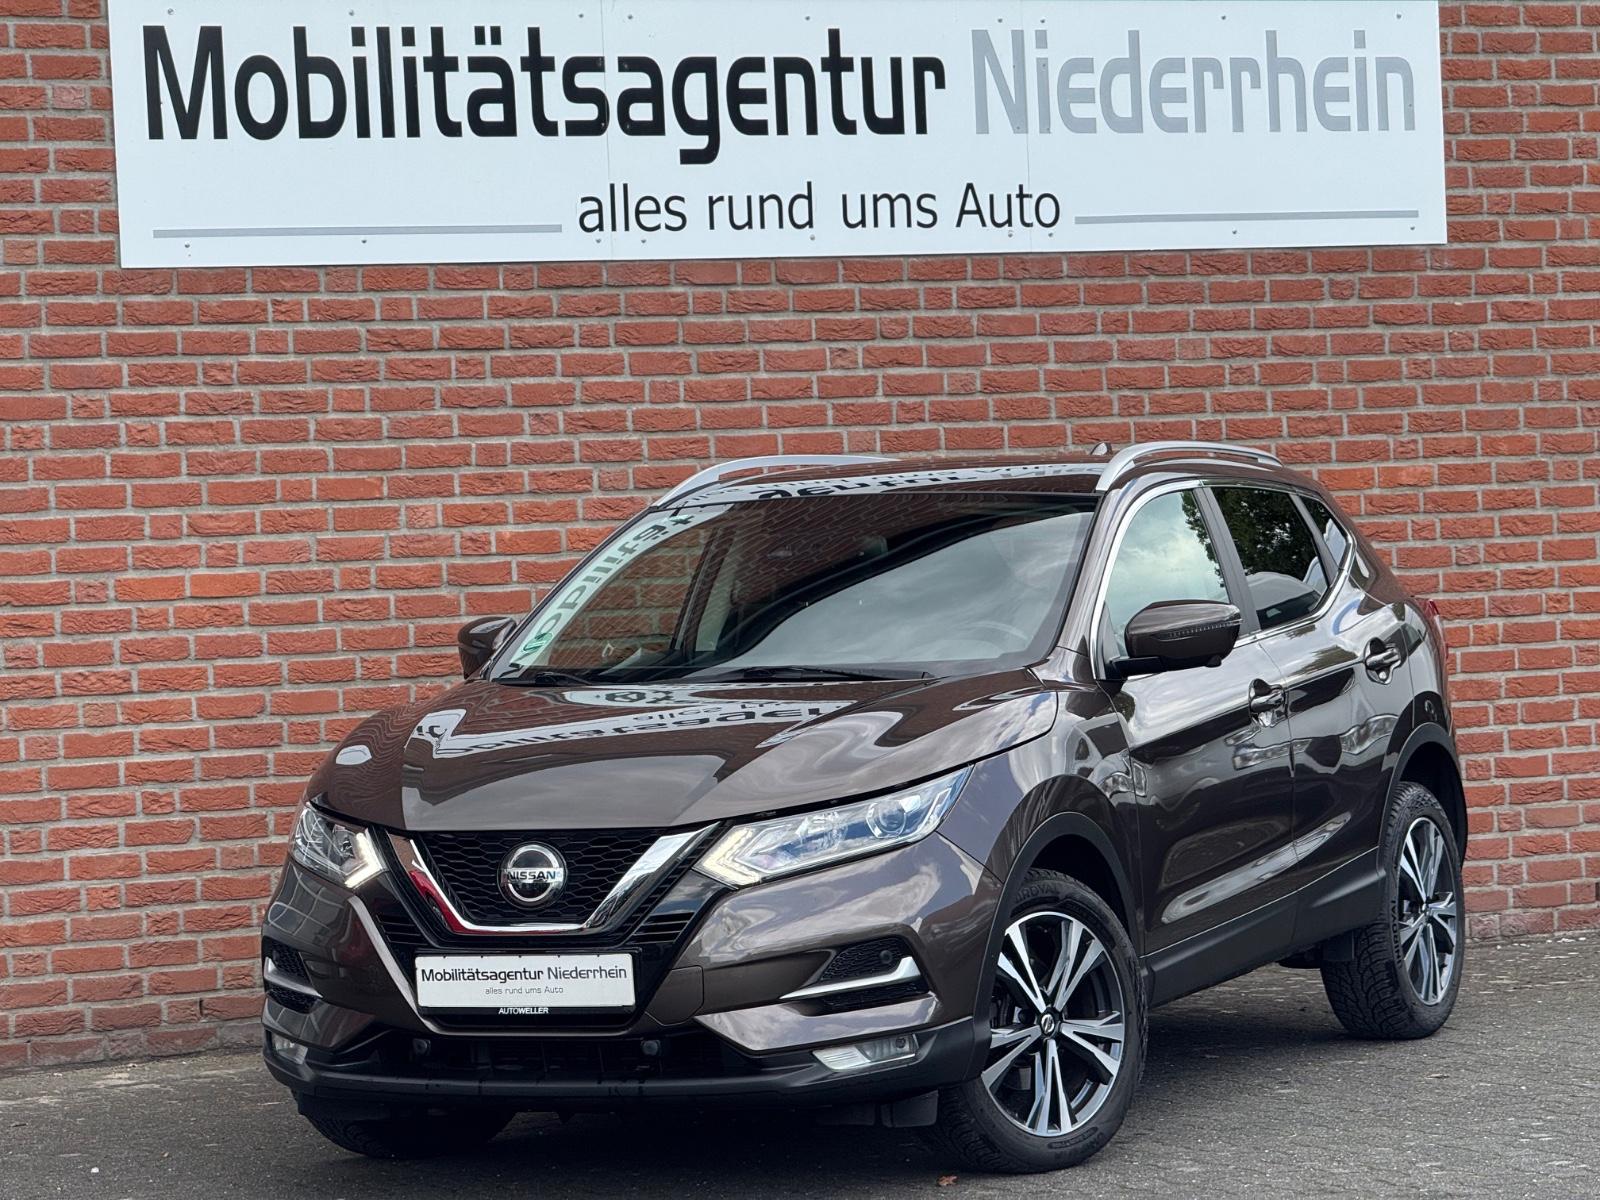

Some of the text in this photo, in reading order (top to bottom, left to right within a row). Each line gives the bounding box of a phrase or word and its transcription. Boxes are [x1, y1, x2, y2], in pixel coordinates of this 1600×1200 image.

[143, 25, 1416, 165] Mobilitätsagentur Niederrhein
[579, 182, 1060, 232] alles rund ums Auto
[507, 870, 556, 880] NISSAN
[421, 966, 628, 984] Mobilitätsagentur Niederrhein
[485, 987, 503, 995] alles
[505, 986, 523, 994] rund
[544, 986, 564, 994] Auto
[498, 1007, 549, 1015] AUTOWELLER
